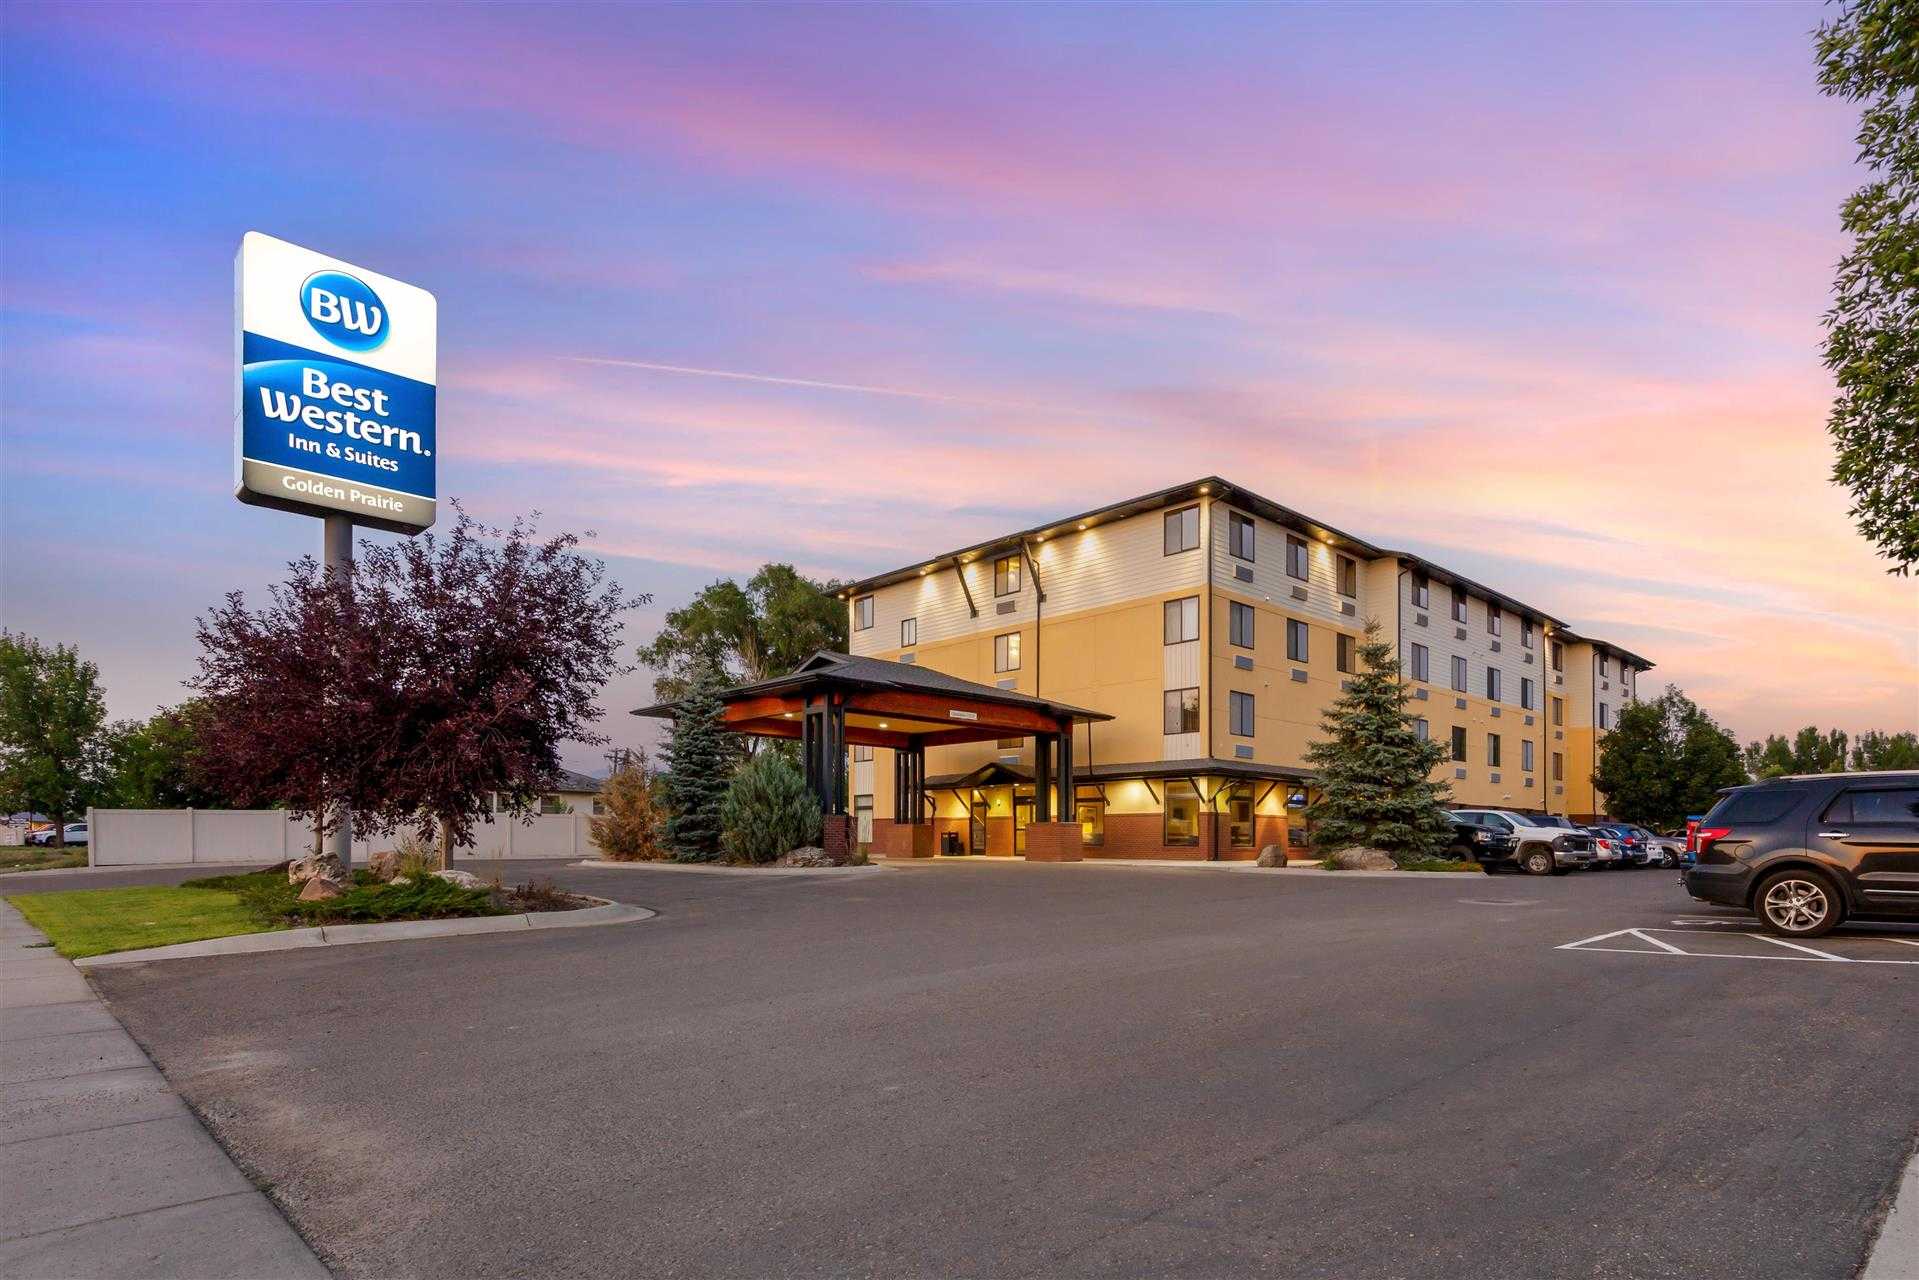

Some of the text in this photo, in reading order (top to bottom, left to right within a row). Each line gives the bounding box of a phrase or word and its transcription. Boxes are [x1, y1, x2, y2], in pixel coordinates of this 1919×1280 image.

[310, 287, 382, 336] BW
[302, 367, 390, 417] Best
[288, 433, 399, 472] Inn & Suites
[282, 475, 404, 513] Golden Prairie
